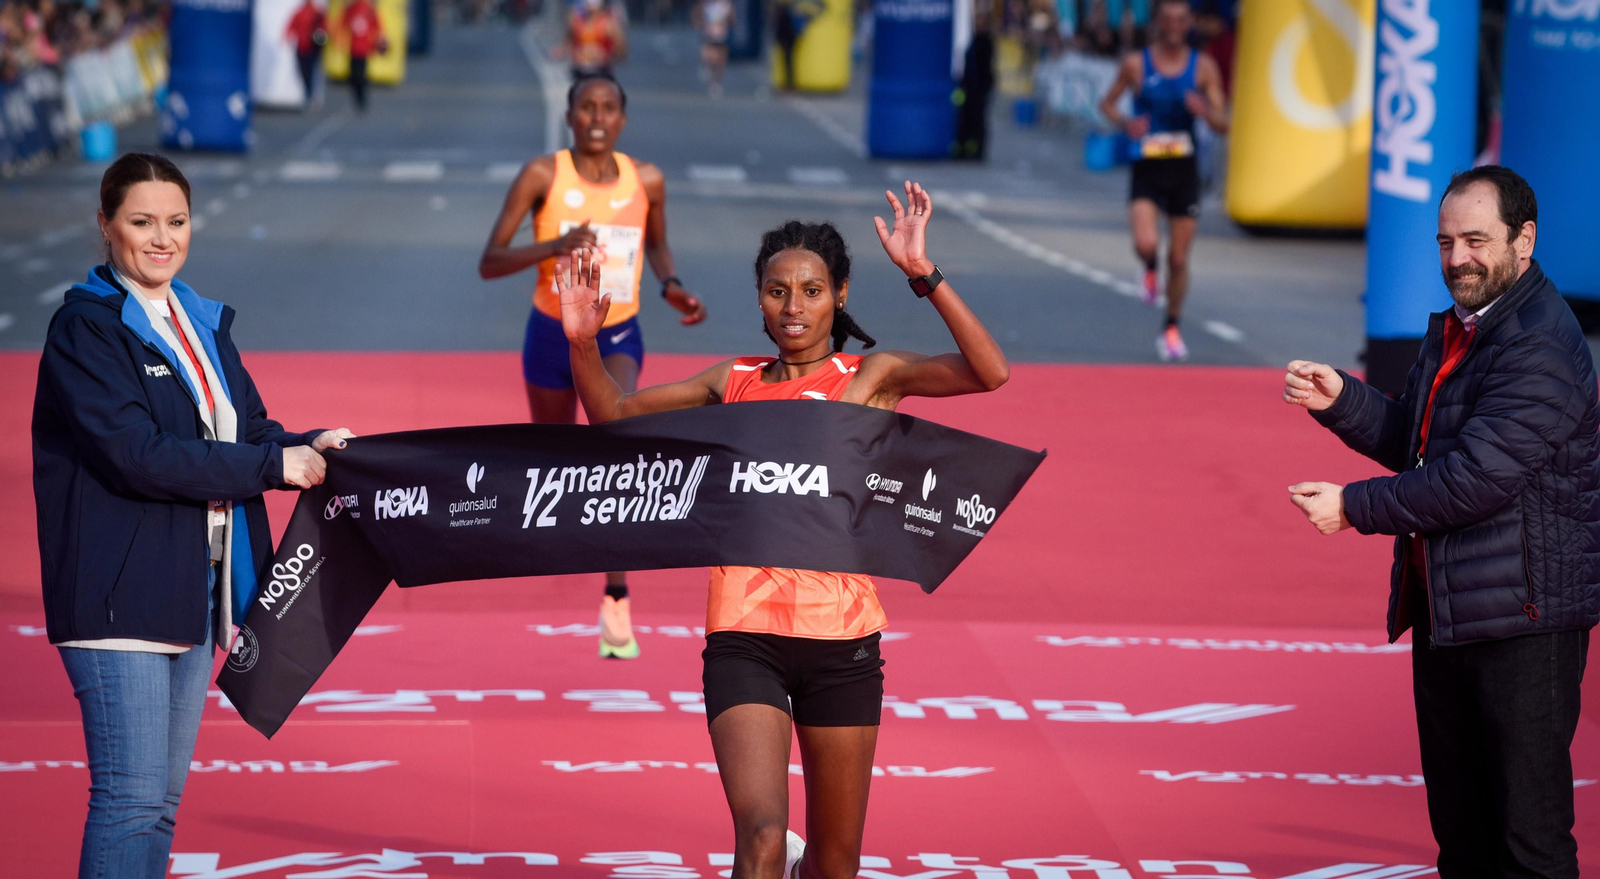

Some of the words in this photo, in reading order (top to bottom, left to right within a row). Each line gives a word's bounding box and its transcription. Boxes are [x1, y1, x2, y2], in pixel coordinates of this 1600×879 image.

[729, 461, 830, 498] HOKA
[374, 485, 429, 521] HOKA
[580, 481, 681, 526] sevilla
[450, 519, 475, 528] Healthcare
[474, 517, 491, 526] Partner
